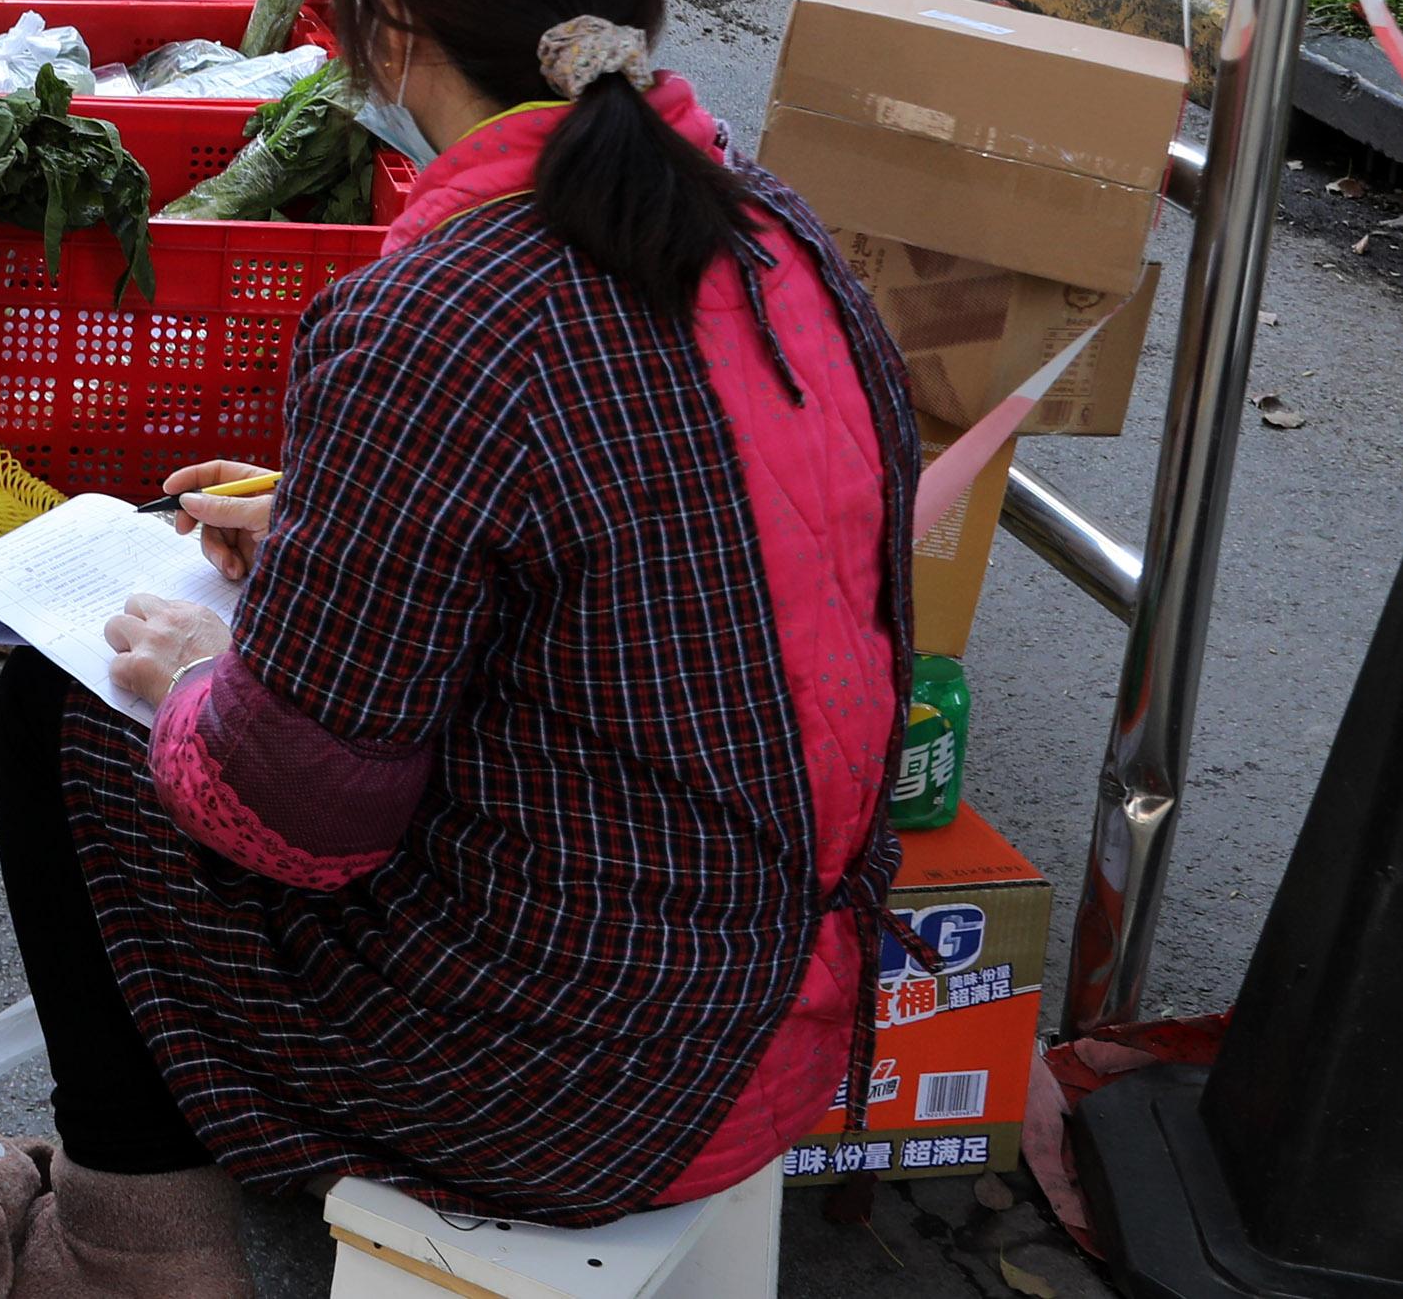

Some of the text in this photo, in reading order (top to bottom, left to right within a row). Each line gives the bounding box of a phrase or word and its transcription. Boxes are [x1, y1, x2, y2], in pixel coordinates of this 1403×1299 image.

[949, 981, 1012, 1009] 超满足
[901, 1136, 988, 1168] 超满足
